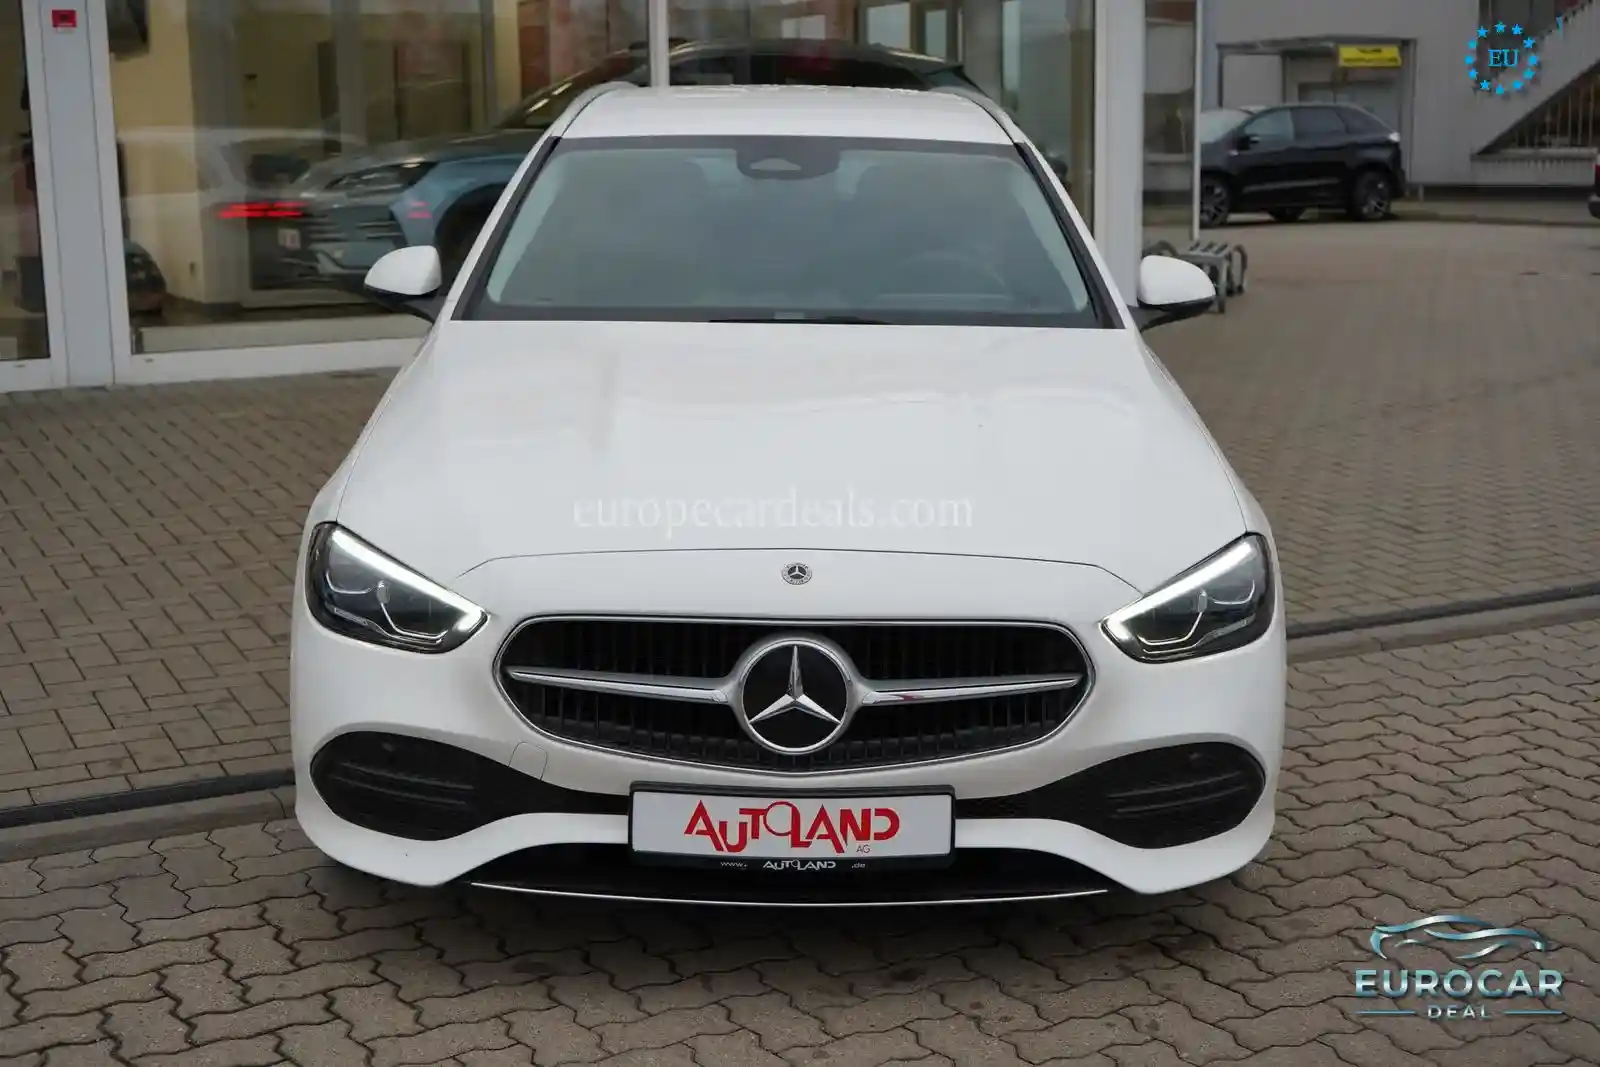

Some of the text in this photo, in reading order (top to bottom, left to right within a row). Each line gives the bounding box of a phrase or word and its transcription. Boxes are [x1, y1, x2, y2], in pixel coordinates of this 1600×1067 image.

[684, 799, 900, 853] AUTOLAND
[856, 844, 871, 854] AG
[762, 859, 837, 871] AUTOLAND
